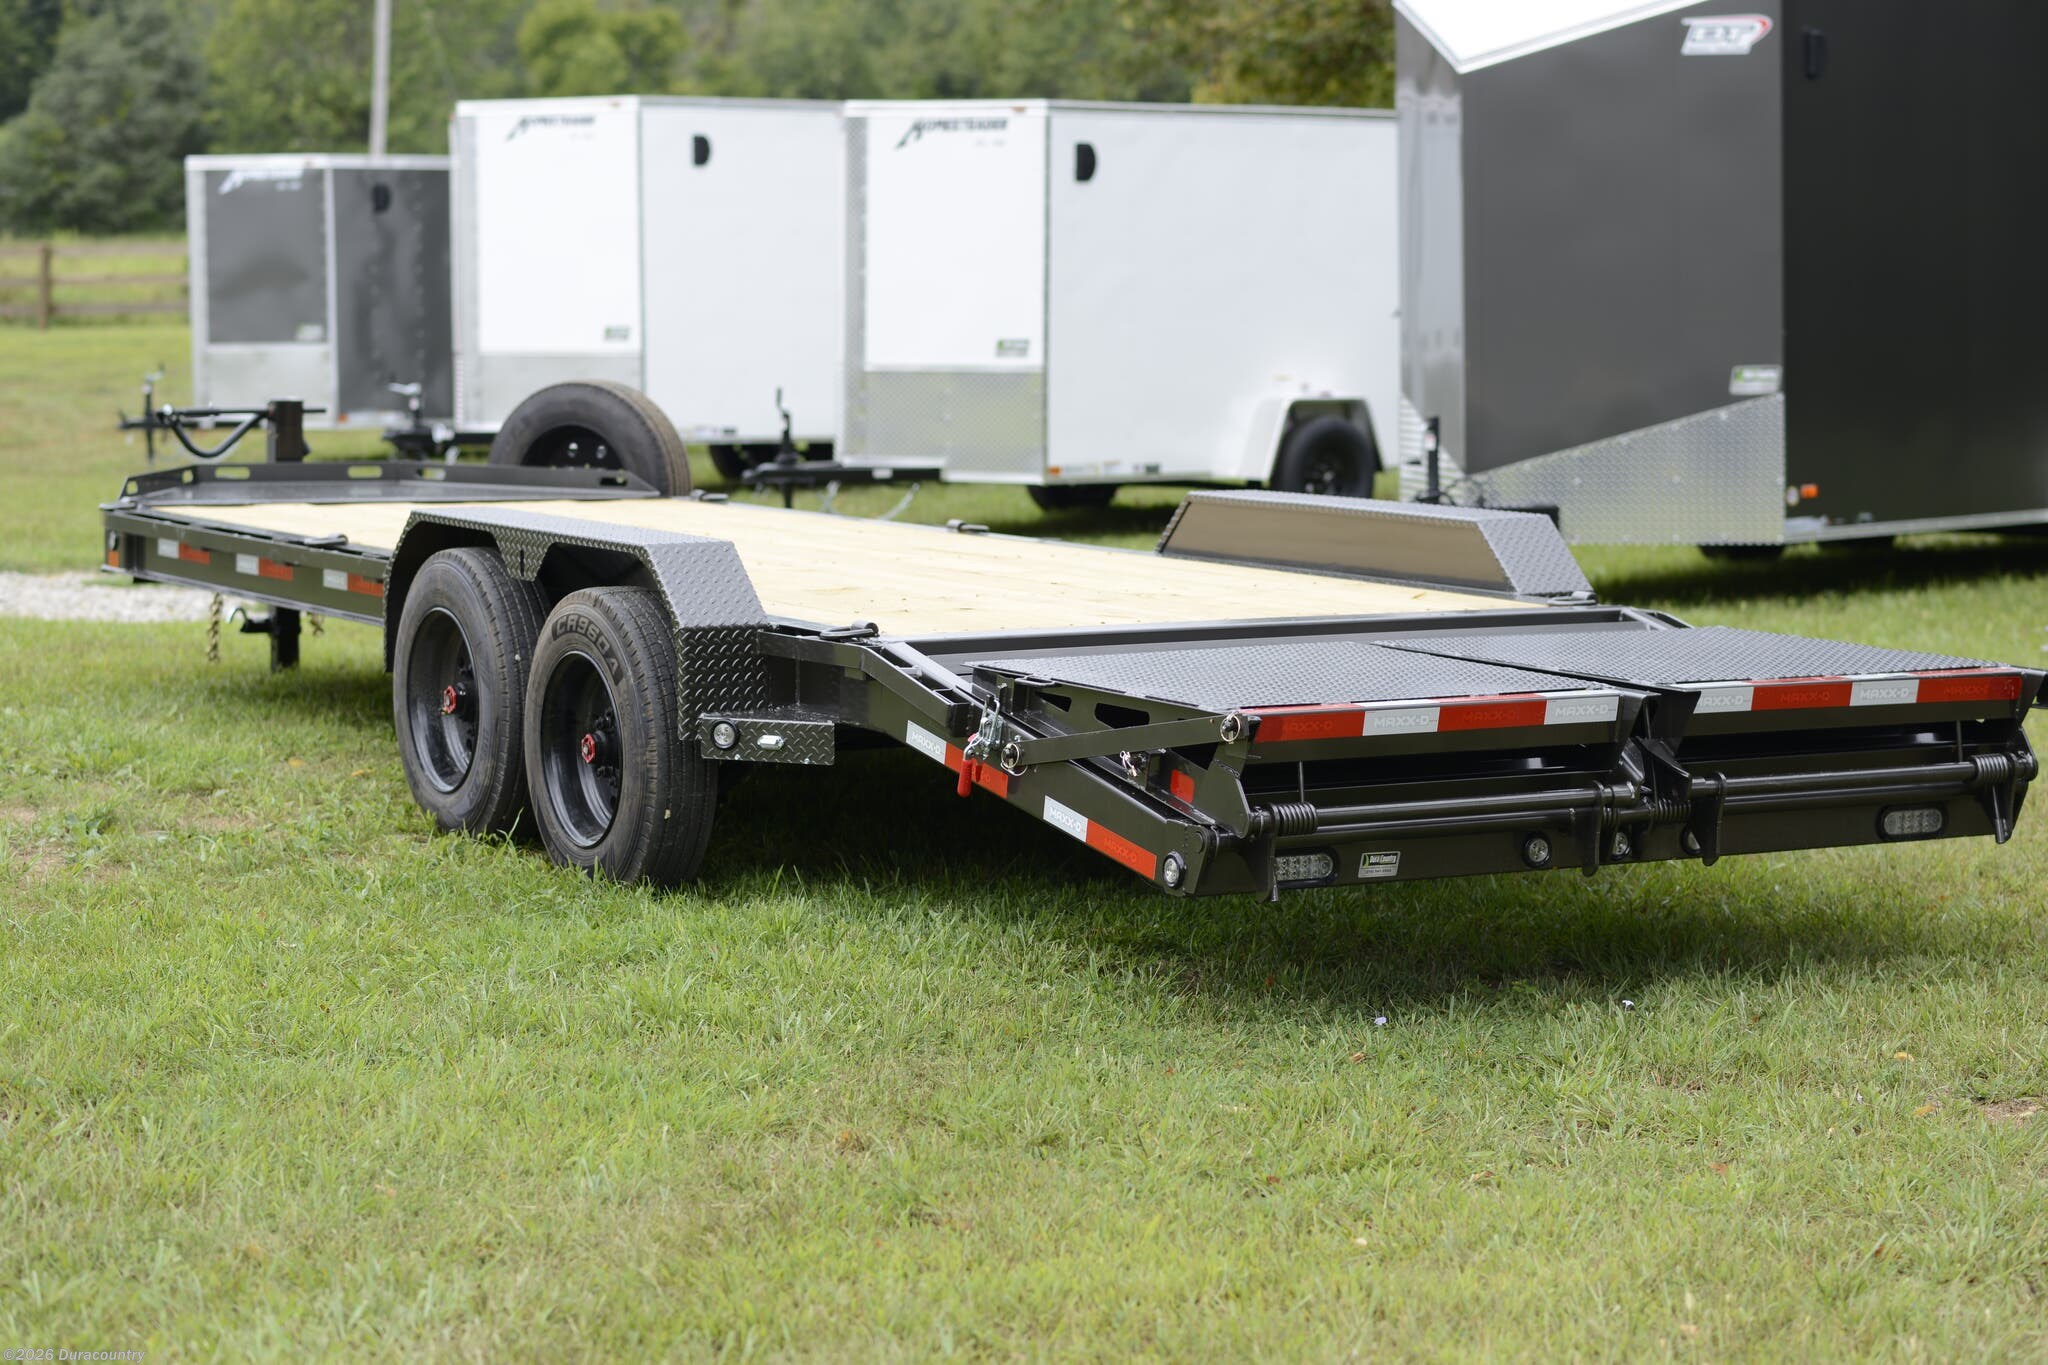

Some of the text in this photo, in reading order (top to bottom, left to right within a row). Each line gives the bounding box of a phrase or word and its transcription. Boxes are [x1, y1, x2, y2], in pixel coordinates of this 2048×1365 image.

[1860, 687, 1909, 700] MAXX-D
[1555, 704, 1609, 717] MAXX-D
[1374, 715, 1430, 729] MAXX-D
[911, 731, 941, 755] MAXX-D
[1049, 806, 1082, 833] MAXX-D
